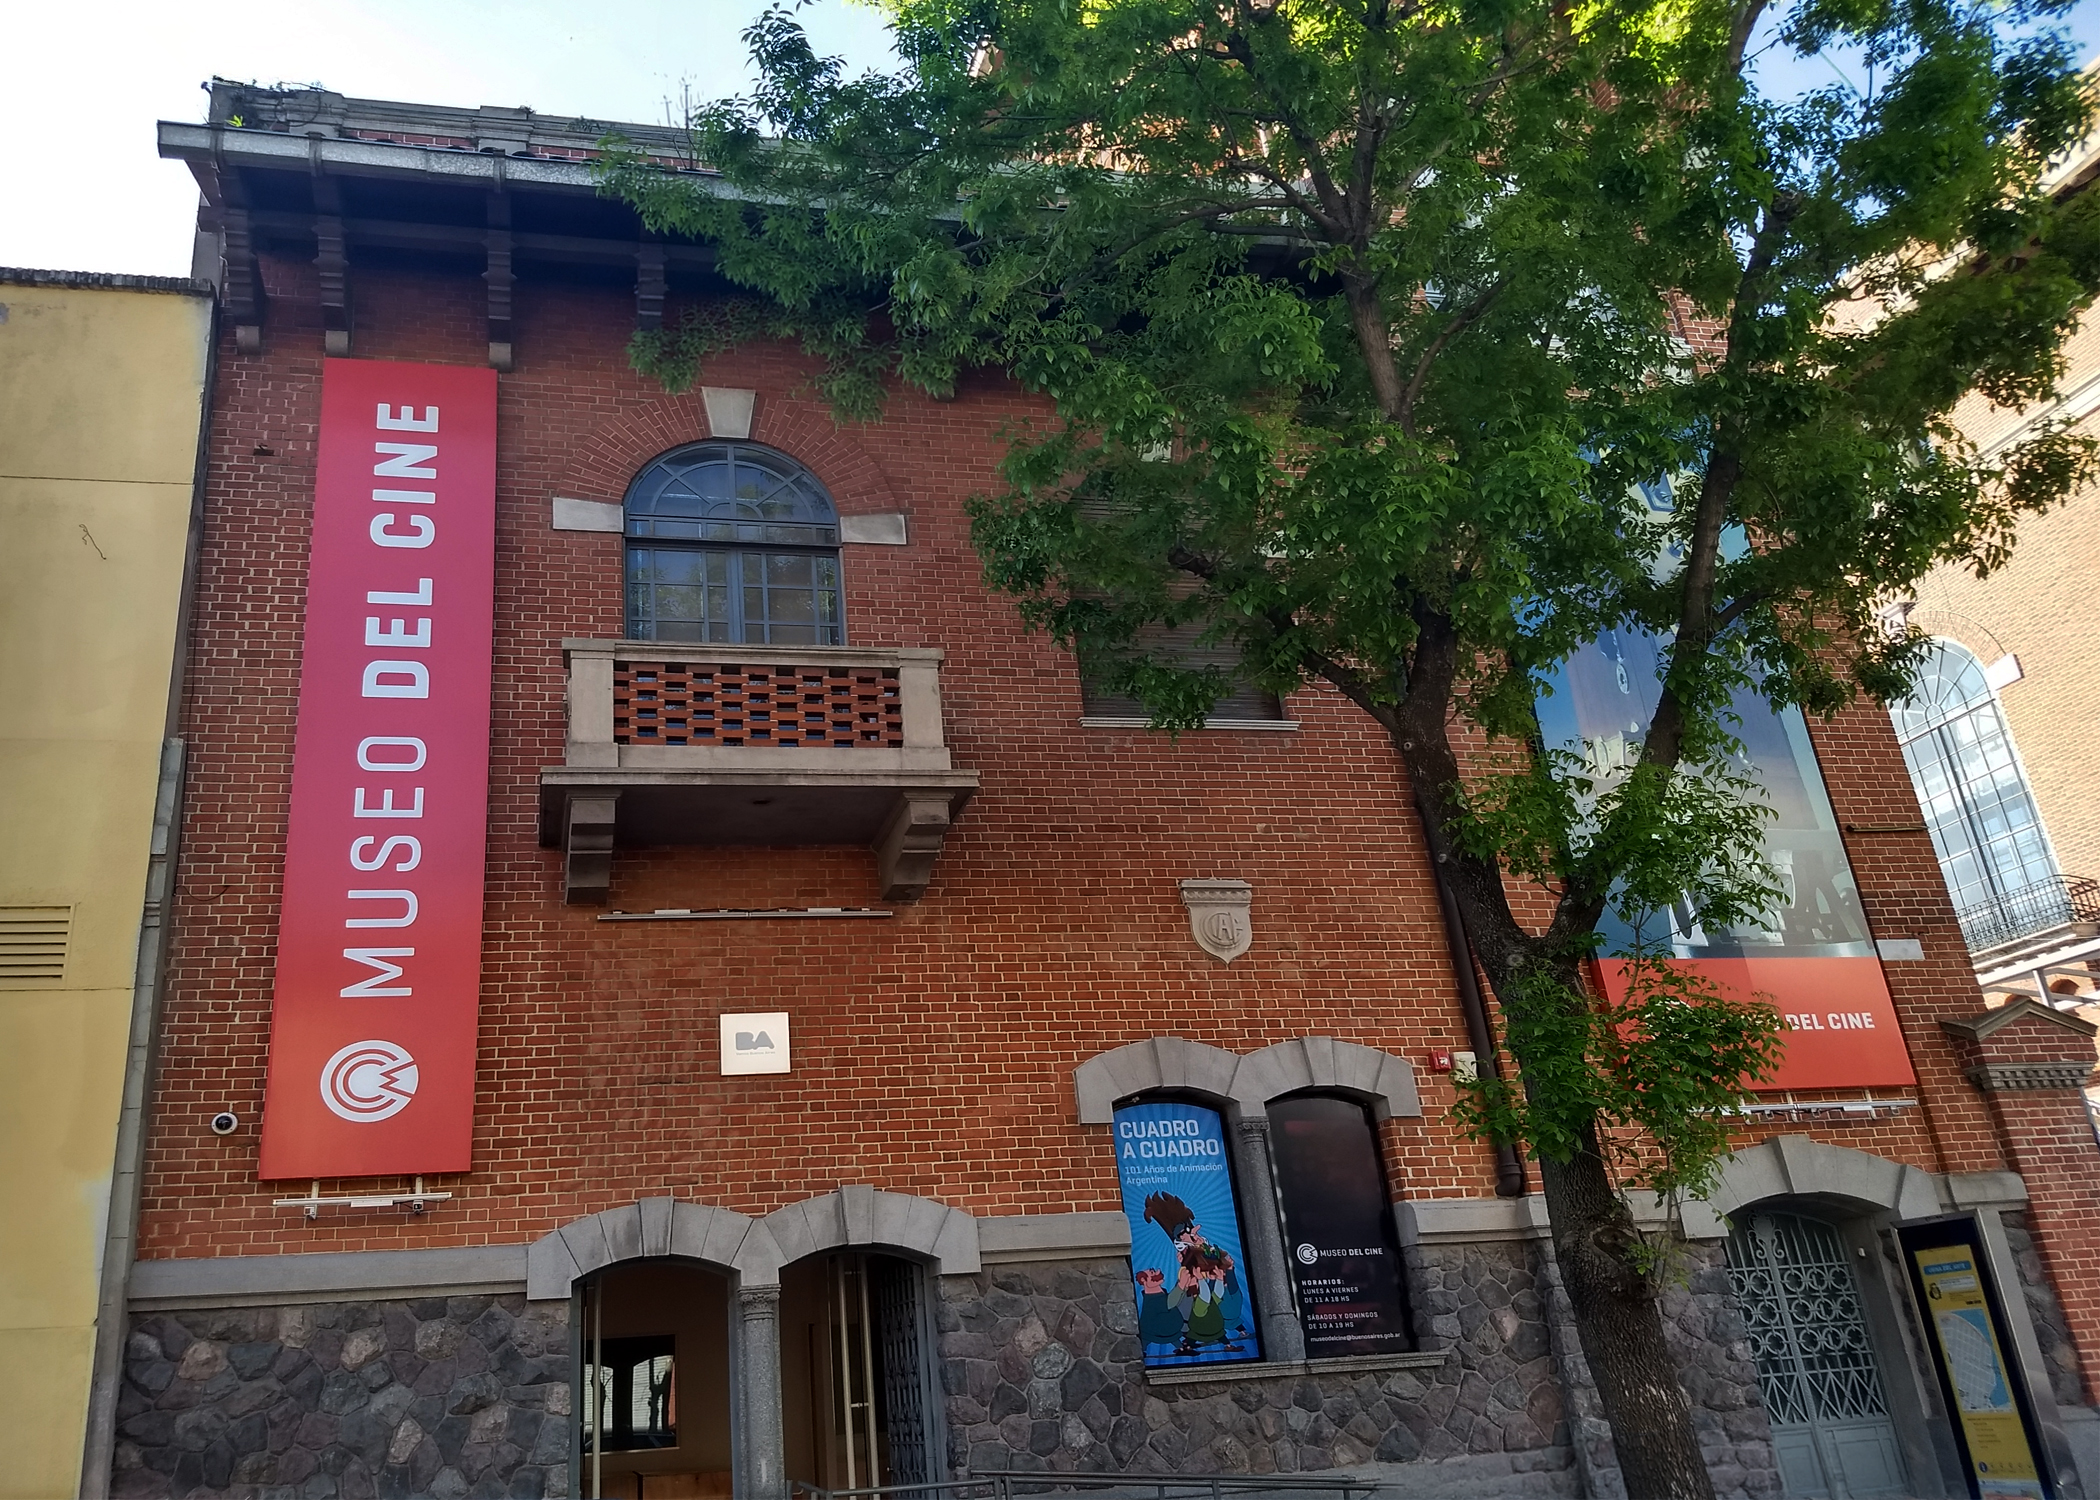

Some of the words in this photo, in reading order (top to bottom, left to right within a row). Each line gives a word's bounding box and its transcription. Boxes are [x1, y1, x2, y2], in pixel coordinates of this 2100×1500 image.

[369, 402, 439, 549] CINE
[362, 577, 433, 699] DEL
[340, 736, 427, 998] MUSEO
[1784, 1013, 1825, 1031] DEL
[1827, 1011, 1875, 1030] CINE
[735, 1031, 775, 1050] BA
[1119, 1120, 1199, 1138] CUADRO
[1123, 1142, 1136, 1159] A
[1140, 1139, 1220, 1158] CUADRO
[1125, 1166, 1141, 1175] 101
[1143, 1165, 1165, 1174] Años
[1166, 1164, 1178, 1173] de
[1179, 1162, 1223, 1172] Animación
[1126, 1175, 1168, 1187] Argentina
[1320, 1249, 1347, 1257] MUSEO
[1348, 1248, 1363, 1256] DEL
[1365, 1247, 1383, 1255] CINE
[1303, 1287, 1324, 1295] LUNES
[1331, 1286, 1359, 1294] VIERNES
[1307, 1313, 1337, 1321] SÁBADOS
[1344, 1311, 1379, 1319] DOMINGOS
